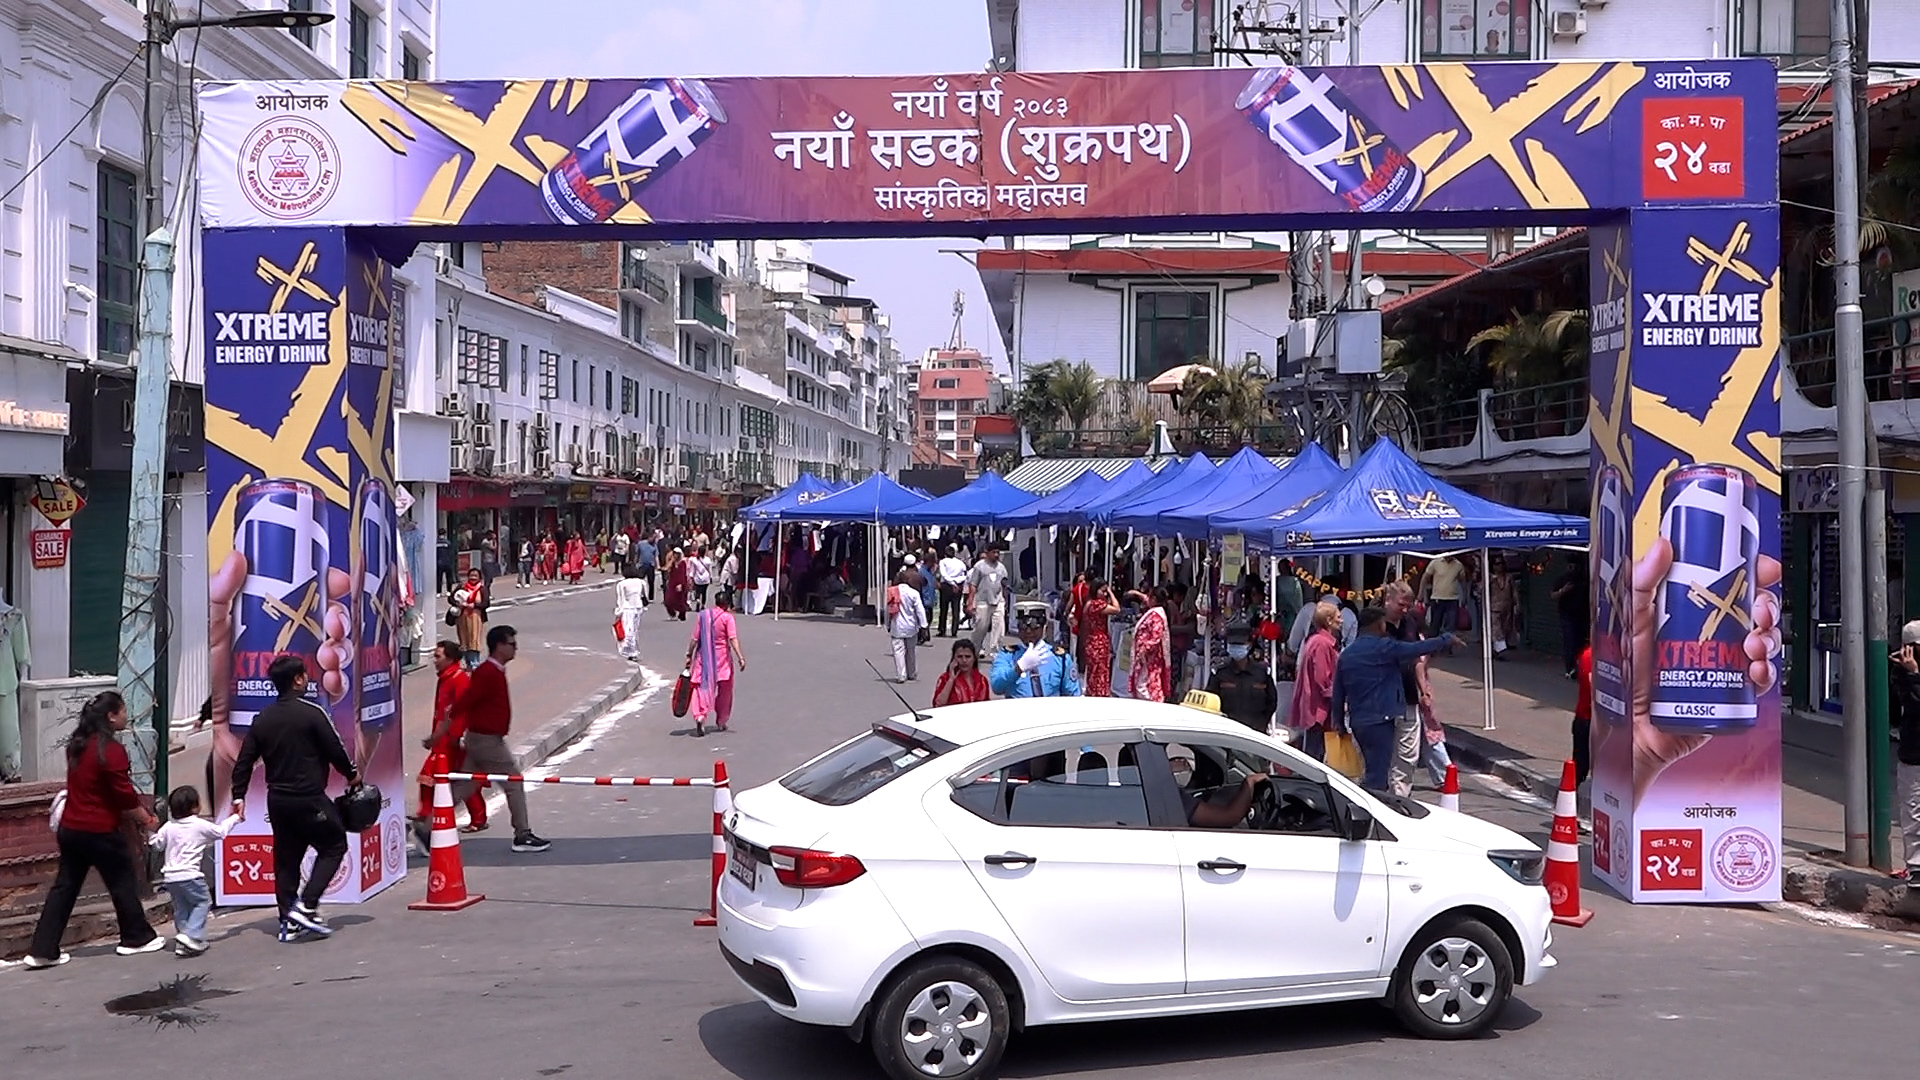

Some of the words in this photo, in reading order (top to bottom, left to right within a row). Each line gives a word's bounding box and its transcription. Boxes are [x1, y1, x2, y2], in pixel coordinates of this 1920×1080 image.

[1654, 66, 1732, 90] आयोजक
[256, 89, 329, 111] आयोजक
[892, 78, 948, 118] नयाँ
[956, 77, 1003, 117] वर्ष
[1013, 98, 1070, 119] २०८३
[1660, 116, 1685, 130] का.
[1688, 115, 1705, 127] म.
[1709, 115, 1726, 130] पा
[770, 110, 855, 169] नयाँ
[868, 128, 979, 170] सडक
[1000, 113, 1192, 182] (शुक्रपथ)
[1654, 141, 1707, 182] २४
[1708, 162, 1731, 174] वडा
[873, 178, 986, 219] सांस्कृतिक
[995, 176, 1088, 212] महोत्सव
[1591, 297, 1625, 333] XTREME
[1640, 293, 1760, 323] XTREME
[214, 311, 328, 342] XTREME
[349, 312, 388, 346] XTREME
[1642, 327, 1704, 347] ENERGY
[1708, 326, 1759, 346] DRINK
[215, 346, 275, 364] ENERGY
[278, 344, 328, 363] DRINK
[350, 346, 371, 365] ENERGY
[43, 501, 73, 514] SALE
[1484, 530, 1518, 539] Xtreme
[1519, 529, 1551, 538] Energy
[1553, 528, 1579, 536] Drink
[36, 543, 63, 557] SALE
[1296, 566, 1340, 597] HAPPY
[1660, 671, 1703, 681] ENERGY
[1706, 671, 1743, 683] DRINK
[1188, 692, 1205, 705] TAXI
[1674, 705, 1716, 716] CLASSIC
[1684, 803, 1736, 819] आयोजक
[228, 860, 262, 886] २४
[1646, 855, 1681, 881] २४
